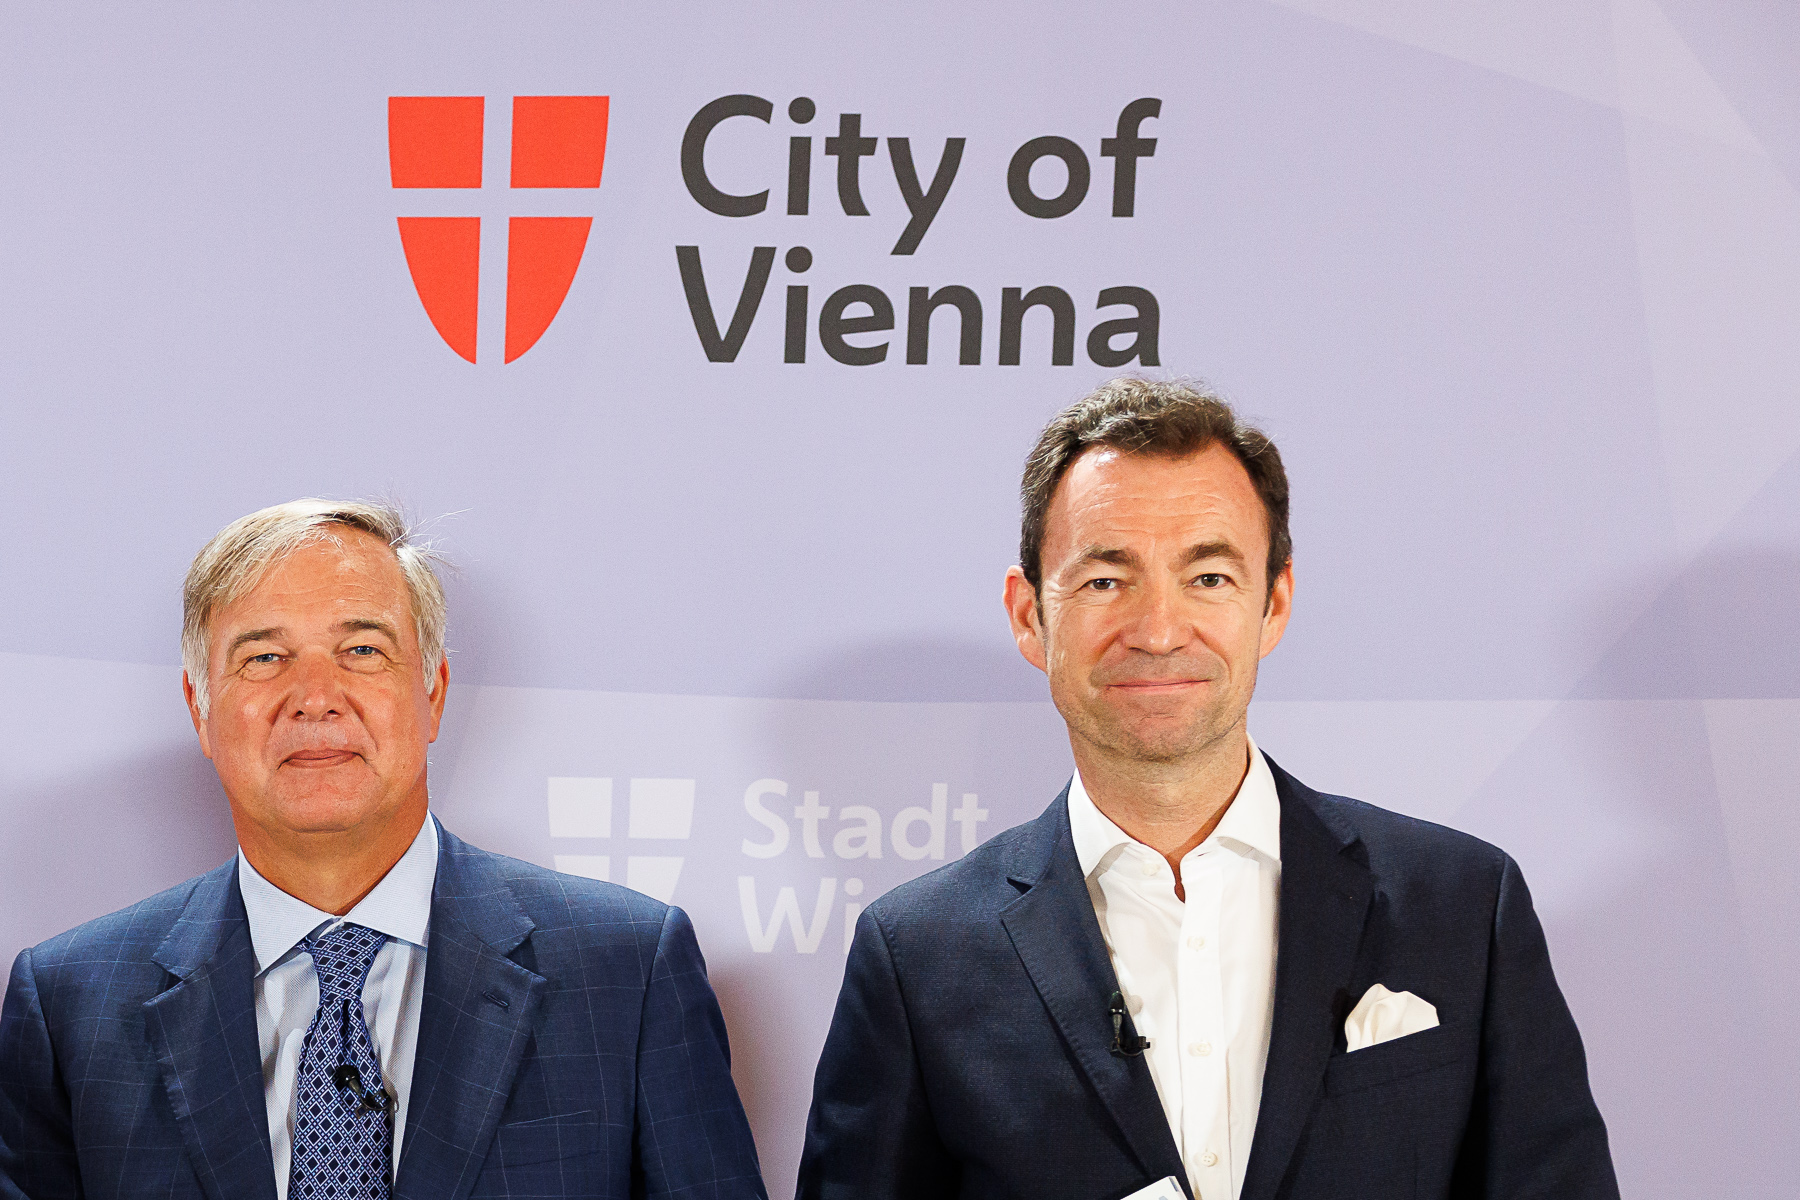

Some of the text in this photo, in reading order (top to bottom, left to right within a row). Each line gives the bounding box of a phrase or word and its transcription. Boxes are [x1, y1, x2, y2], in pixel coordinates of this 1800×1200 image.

[680, 93, 1163, 256] City of
[675, 244, 1163, 368] Vienna
[741, 778, 989, 861] Stadt
[737, 875, 865, 956] Wi
